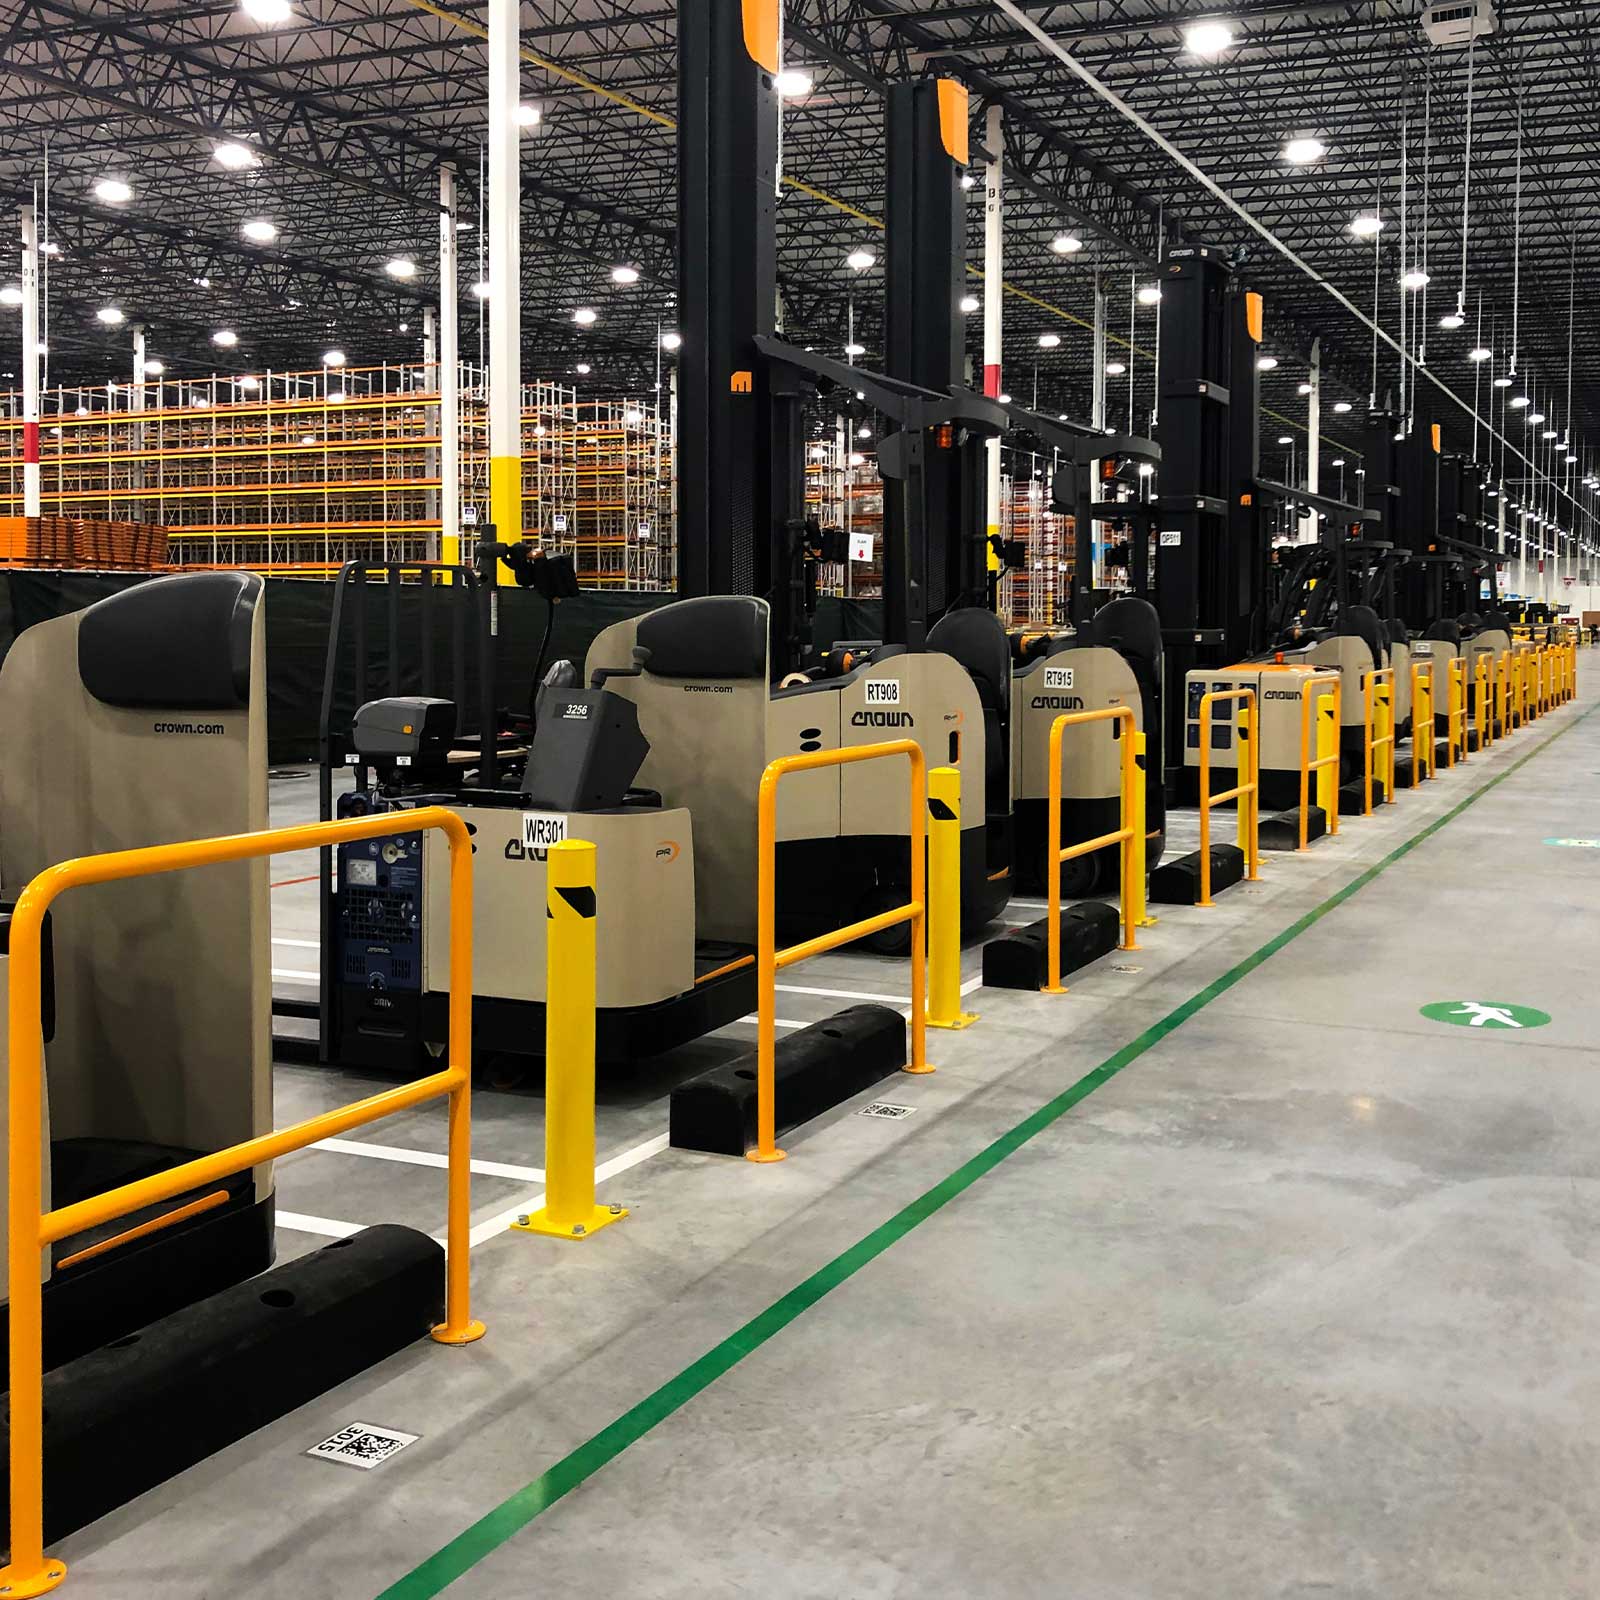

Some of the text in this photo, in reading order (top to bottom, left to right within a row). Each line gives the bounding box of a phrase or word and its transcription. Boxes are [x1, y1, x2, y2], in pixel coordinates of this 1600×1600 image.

[1046, 671, 1073, 686] RT915
[684, 685, 733, 693] crown.com
[867, 684, 898, 701] RT908
[1264, 690, 1302, 700] CROWN
[566, 704, 588, 715] 3256
[1031, 696, 1085, 709] CROWN
[850, 711, 914, 727] CROWN
[154, 722, 224, 735] crown.com
[525, 818, 564, 844] WR301
[317, 1426, 363, 1452] 3015
